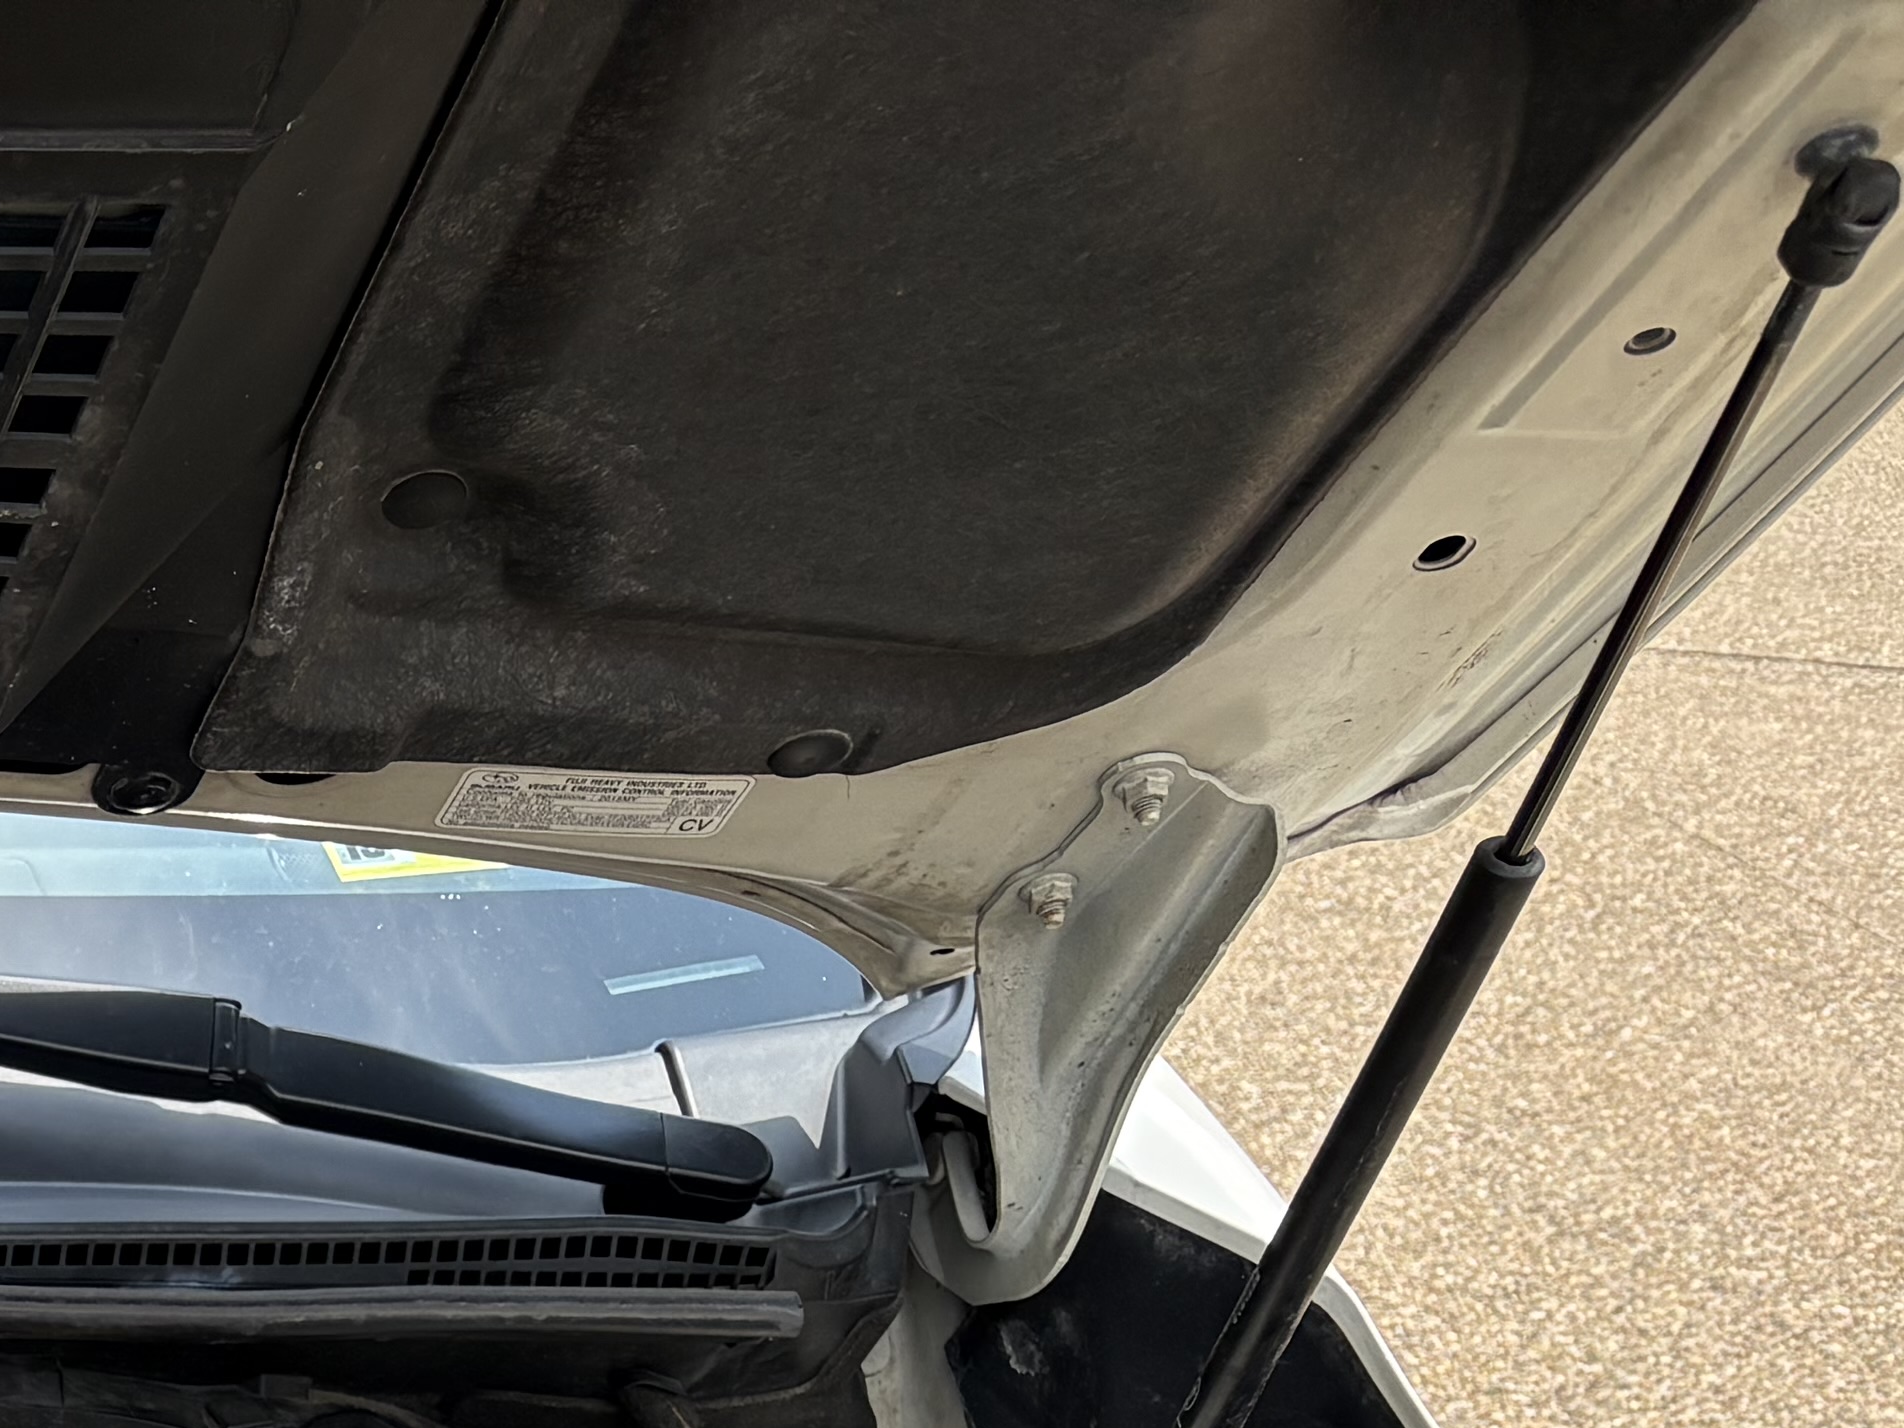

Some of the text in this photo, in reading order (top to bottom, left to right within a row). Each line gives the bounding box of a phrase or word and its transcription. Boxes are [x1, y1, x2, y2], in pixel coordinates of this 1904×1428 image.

[527, 783, 737, 798] VEHICLE EMISSION CONTROL INFORMATION
[590, 779, 623, 787] HEAVY
[625, 780, 684, 789] INDUSTRIES
[678, 818, 715, 832] CV
